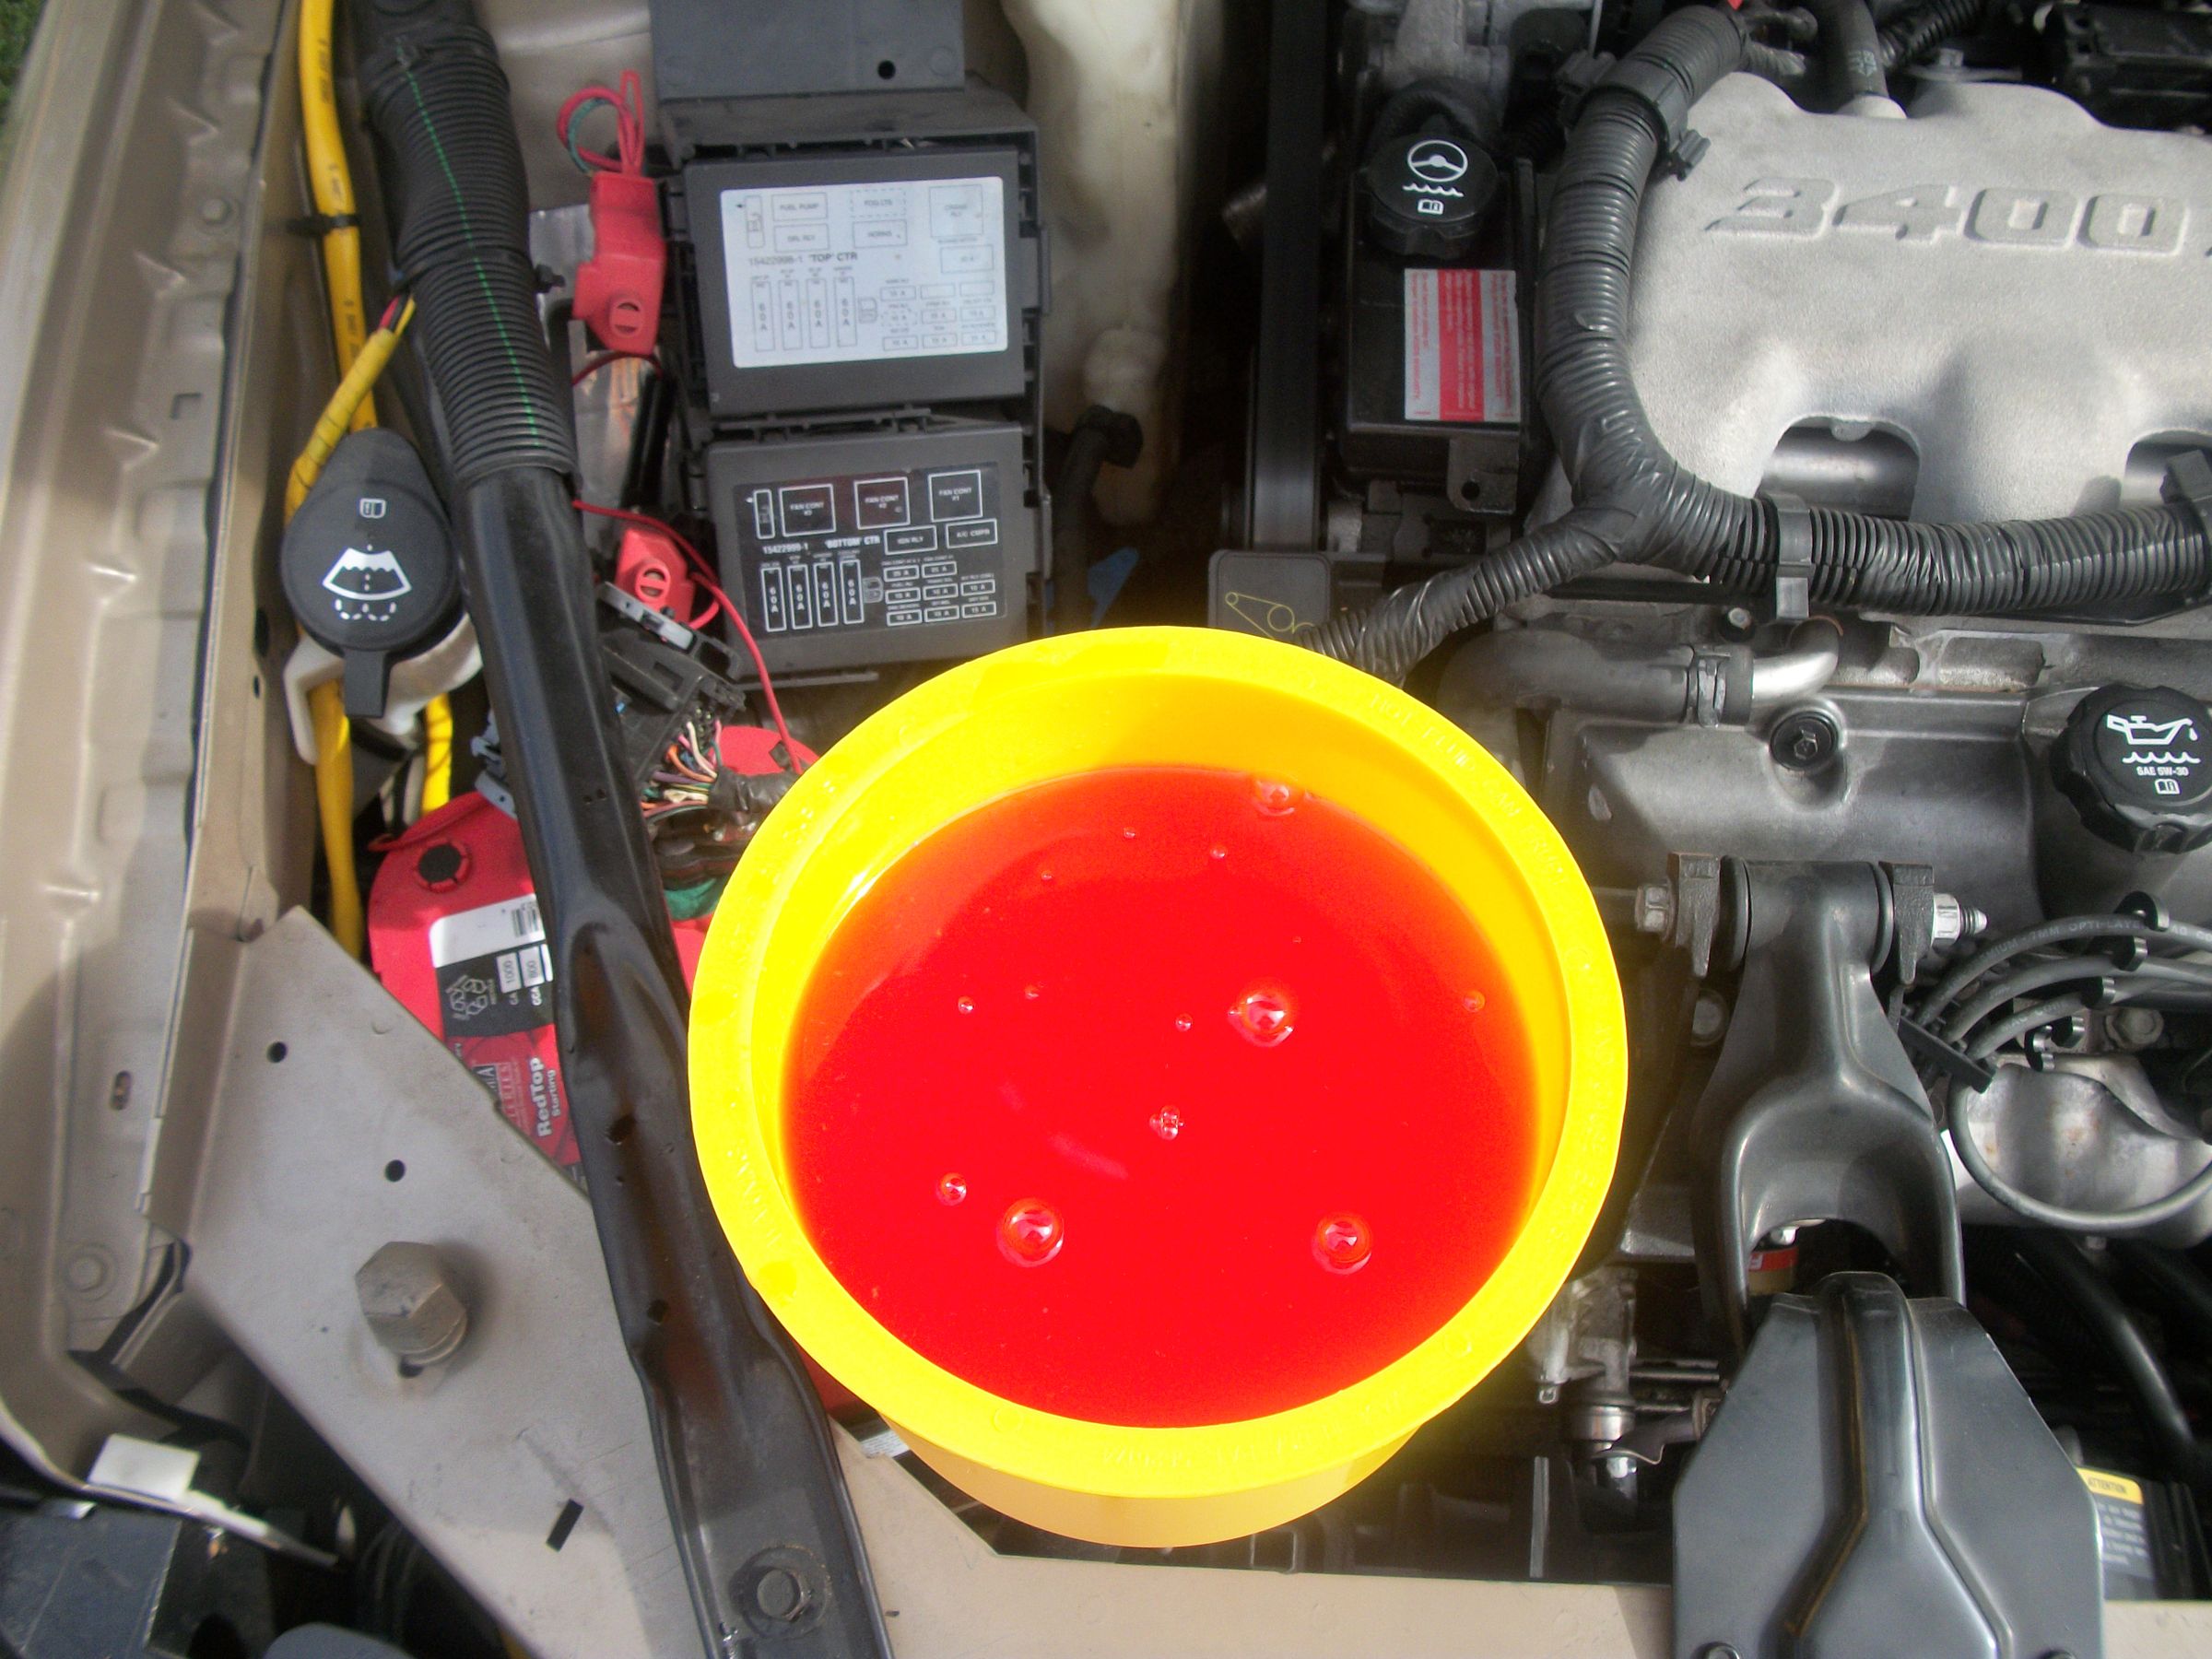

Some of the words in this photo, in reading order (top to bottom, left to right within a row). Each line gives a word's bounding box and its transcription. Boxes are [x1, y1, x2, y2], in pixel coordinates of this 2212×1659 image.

[1705, 177, 2190, 256] 3400
[836, 251, 858, 262] CTR
[864, 535, 881, 545] CTR
[2136, 766, 2157, 776] SAE
[2158, 766, 2190, 777] 5W-30
[530, 986, 543, 1006] CCA
[530, 1057, 553, 1137] RedTop
[547, 1069, 561, 1117] Starting
[2088, 1477, 2127, 1495] ATTENTION
